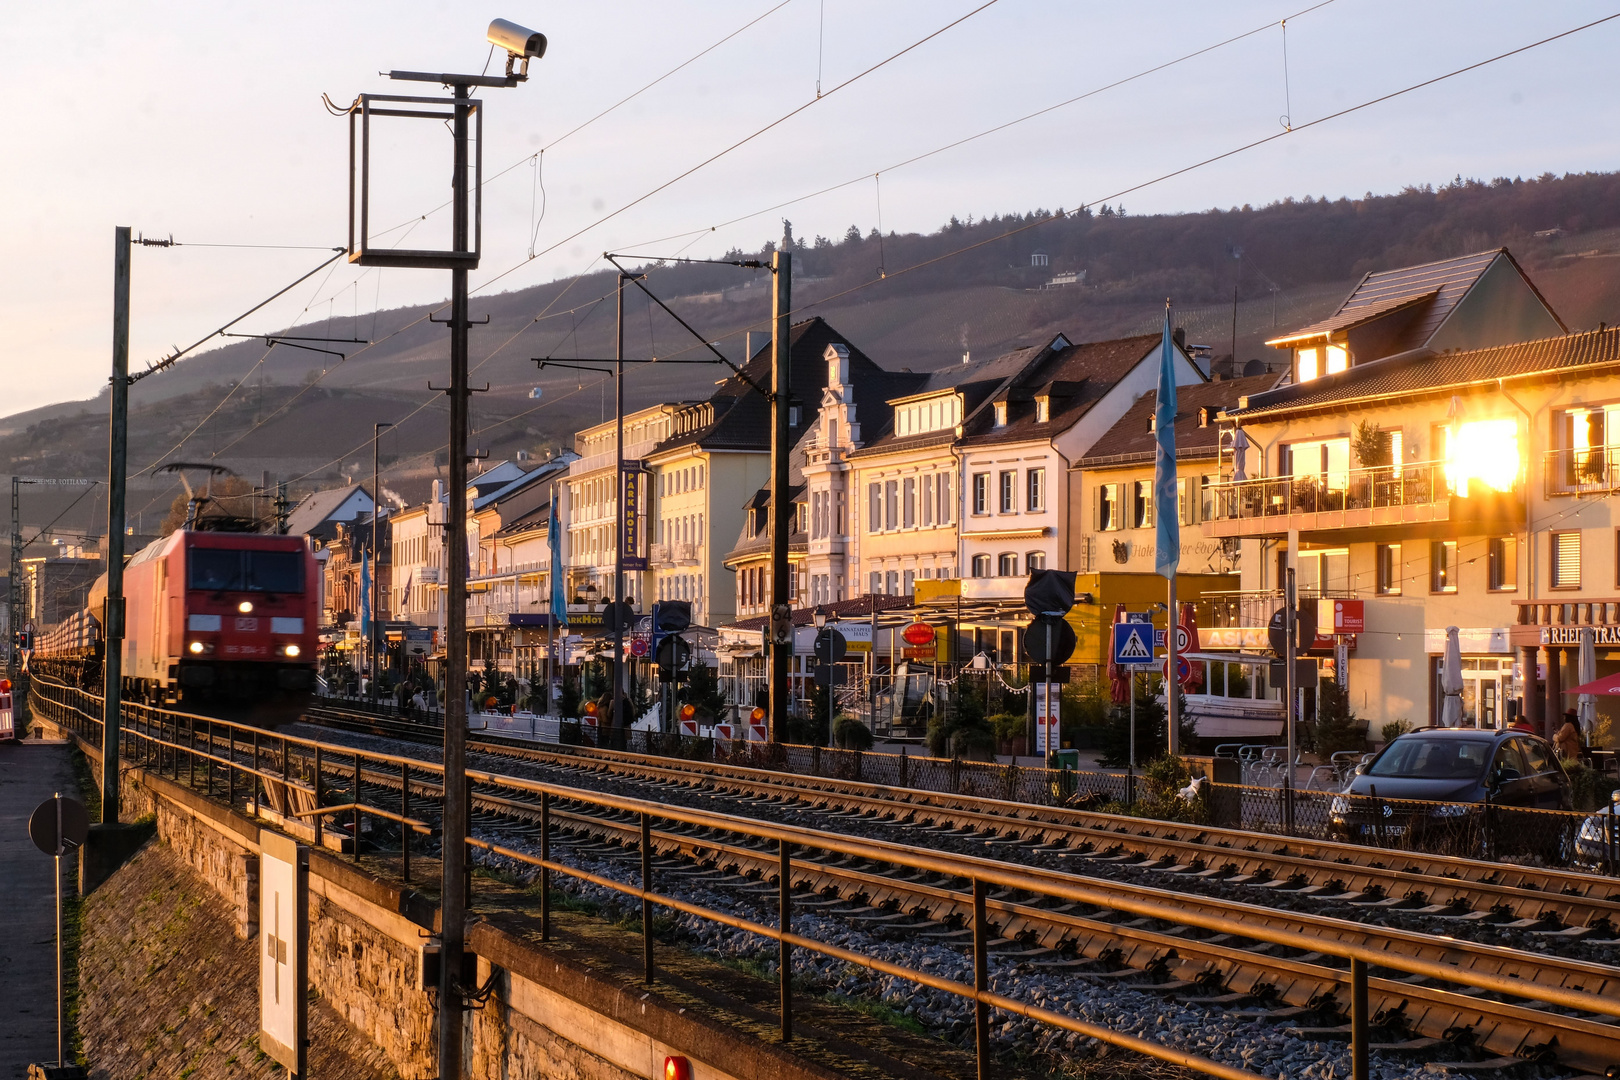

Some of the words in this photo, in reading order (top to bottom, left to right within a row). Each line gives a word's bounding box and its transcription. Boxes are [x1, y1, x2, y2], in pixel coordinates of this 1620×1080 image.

[627, 473, 635, 506] PARK
[626, 510, 635, 552] HOTEL
[1131, 544, 1155, 557] Hote
[772, 606, 792, 621] 64
[1208, 631, 1257, 645] ASIA
